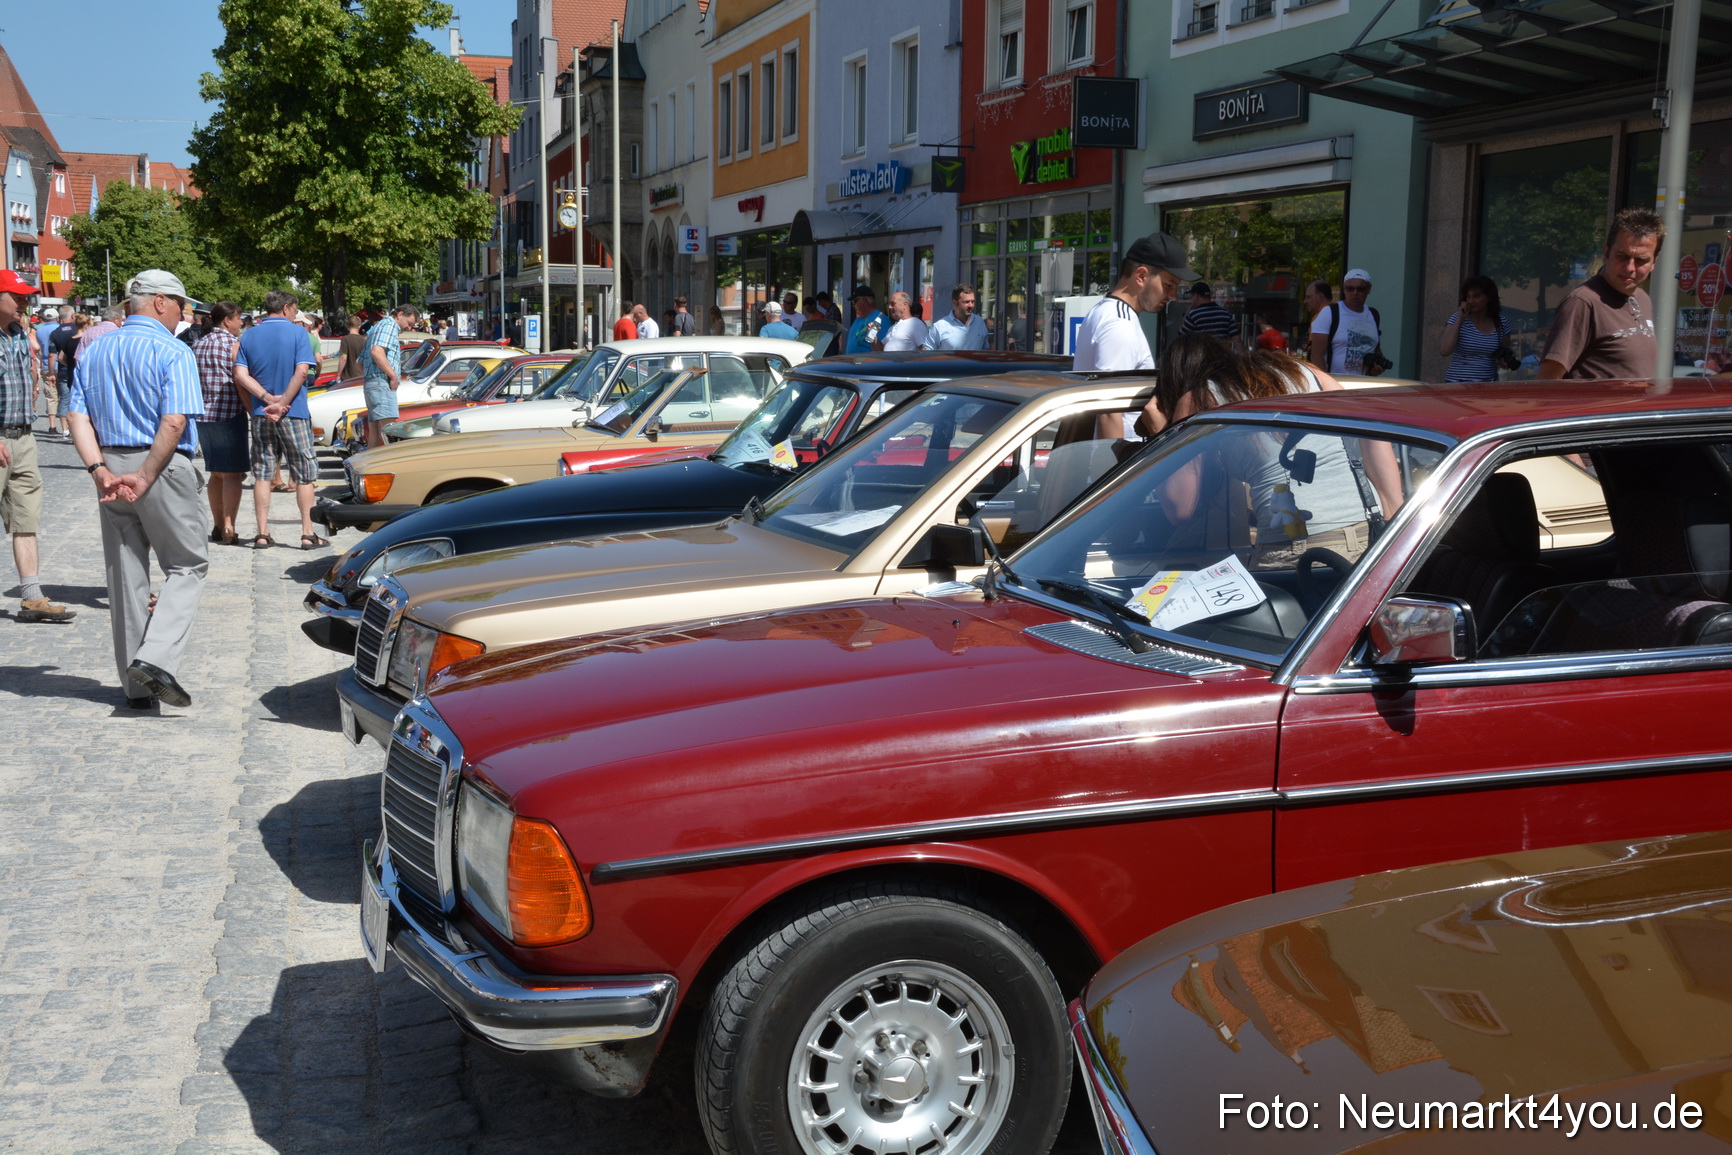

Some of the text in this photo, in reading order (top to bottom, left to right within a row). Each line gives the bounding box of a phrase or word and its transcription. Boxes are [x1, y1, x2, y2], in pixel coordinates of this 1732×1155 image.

[1218, 90, 1265, 122] BONITA
[1081, 114, 1130, 131] BONITA
[1037, 157, 1070, 183] debitel
[1008, 240, 1028, 253] GRAVIS
[1681, 272, 1694, 280] 15%
[530, 322, 536, 330] P
[1205, 581, 1245, 607] 148
